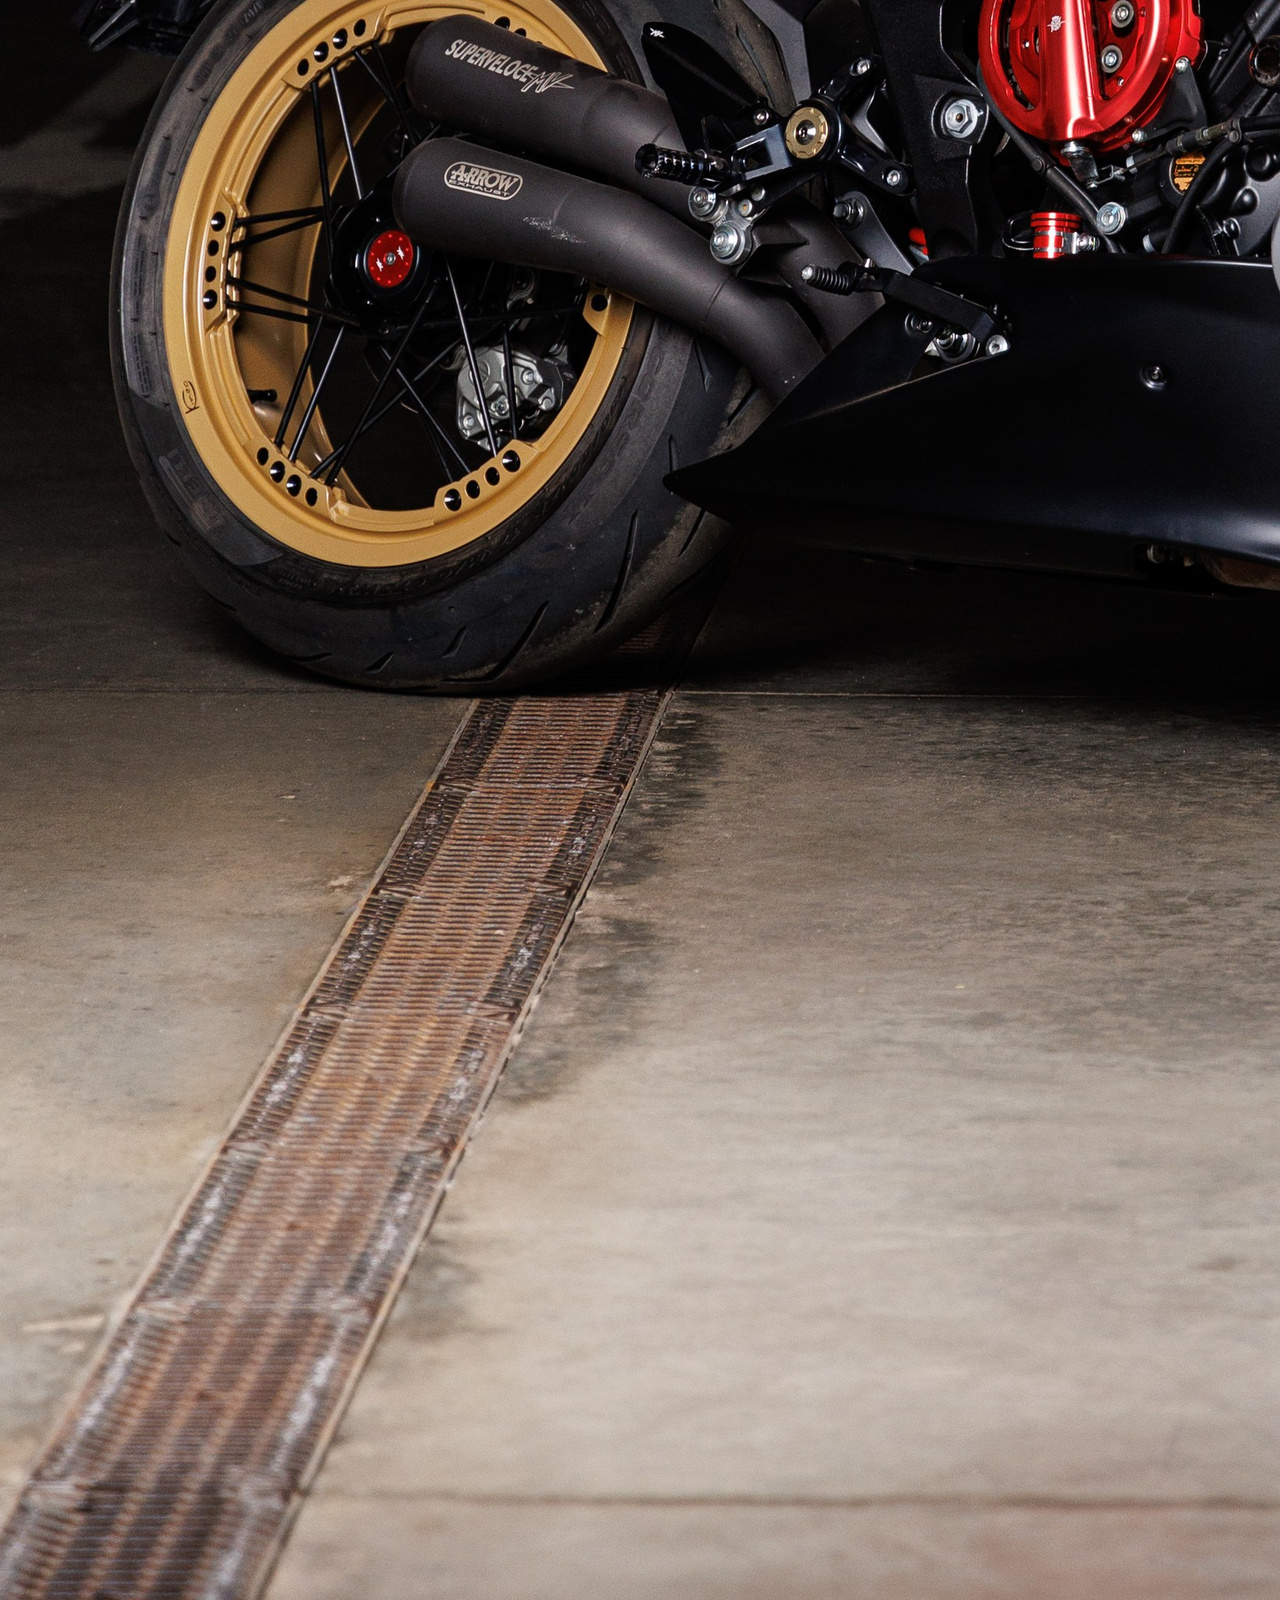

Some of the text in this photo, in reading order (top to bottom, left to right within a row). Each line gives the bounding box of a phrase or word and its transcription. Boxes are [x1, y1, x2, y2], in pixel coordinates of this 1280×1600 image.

[444, 39, 539, 83] SUPERVELOCE
[449, 179, 510, 197] EXHAUST
[450, 164, 519, 192] ARROW
